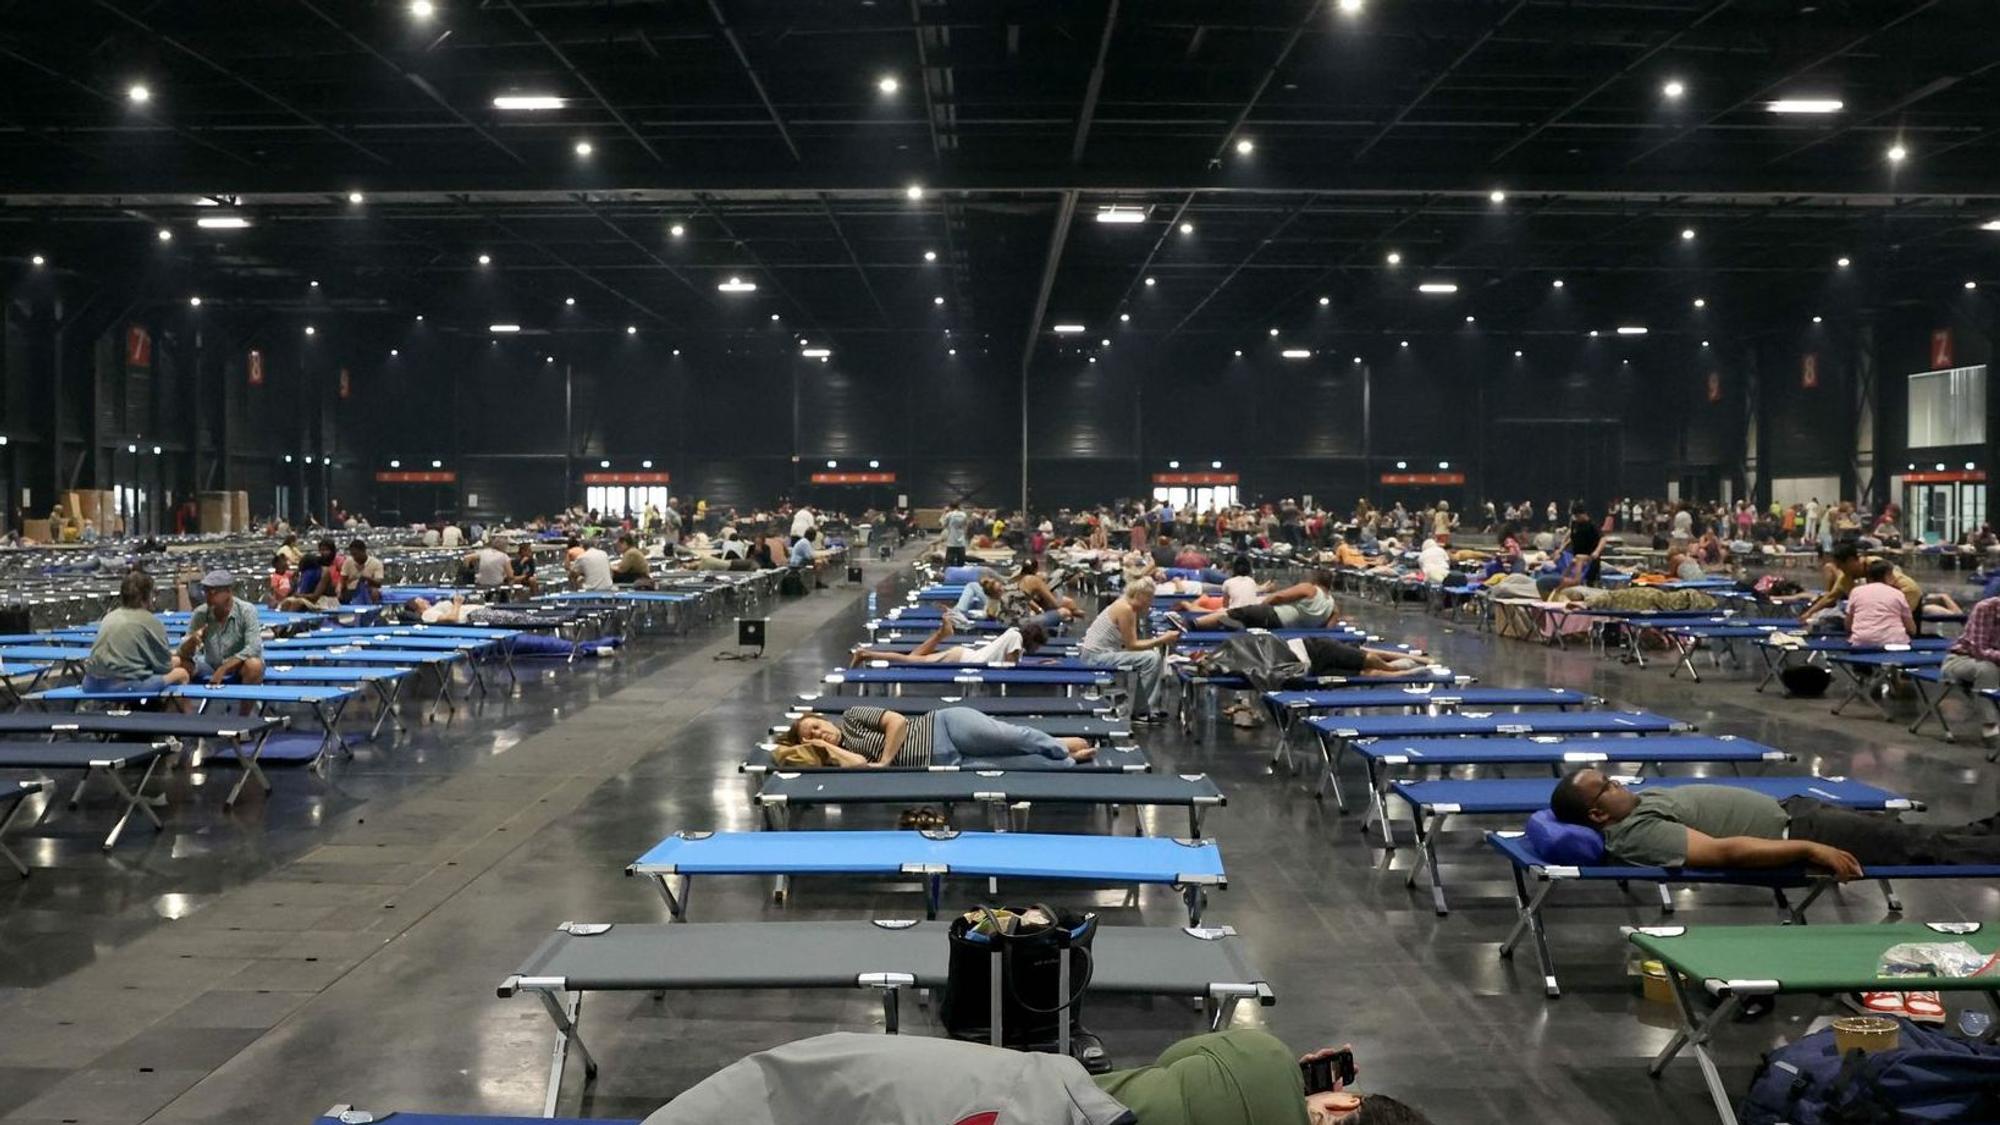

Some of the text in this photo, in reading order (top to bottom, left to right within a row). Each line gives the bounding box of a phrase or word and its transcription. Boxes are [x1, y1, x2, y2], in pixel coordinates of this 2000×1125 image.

[132, 327, 145, 360] 7
[251, 352, 261, 380] 8
[1804, 355, 1816, 383] 8
